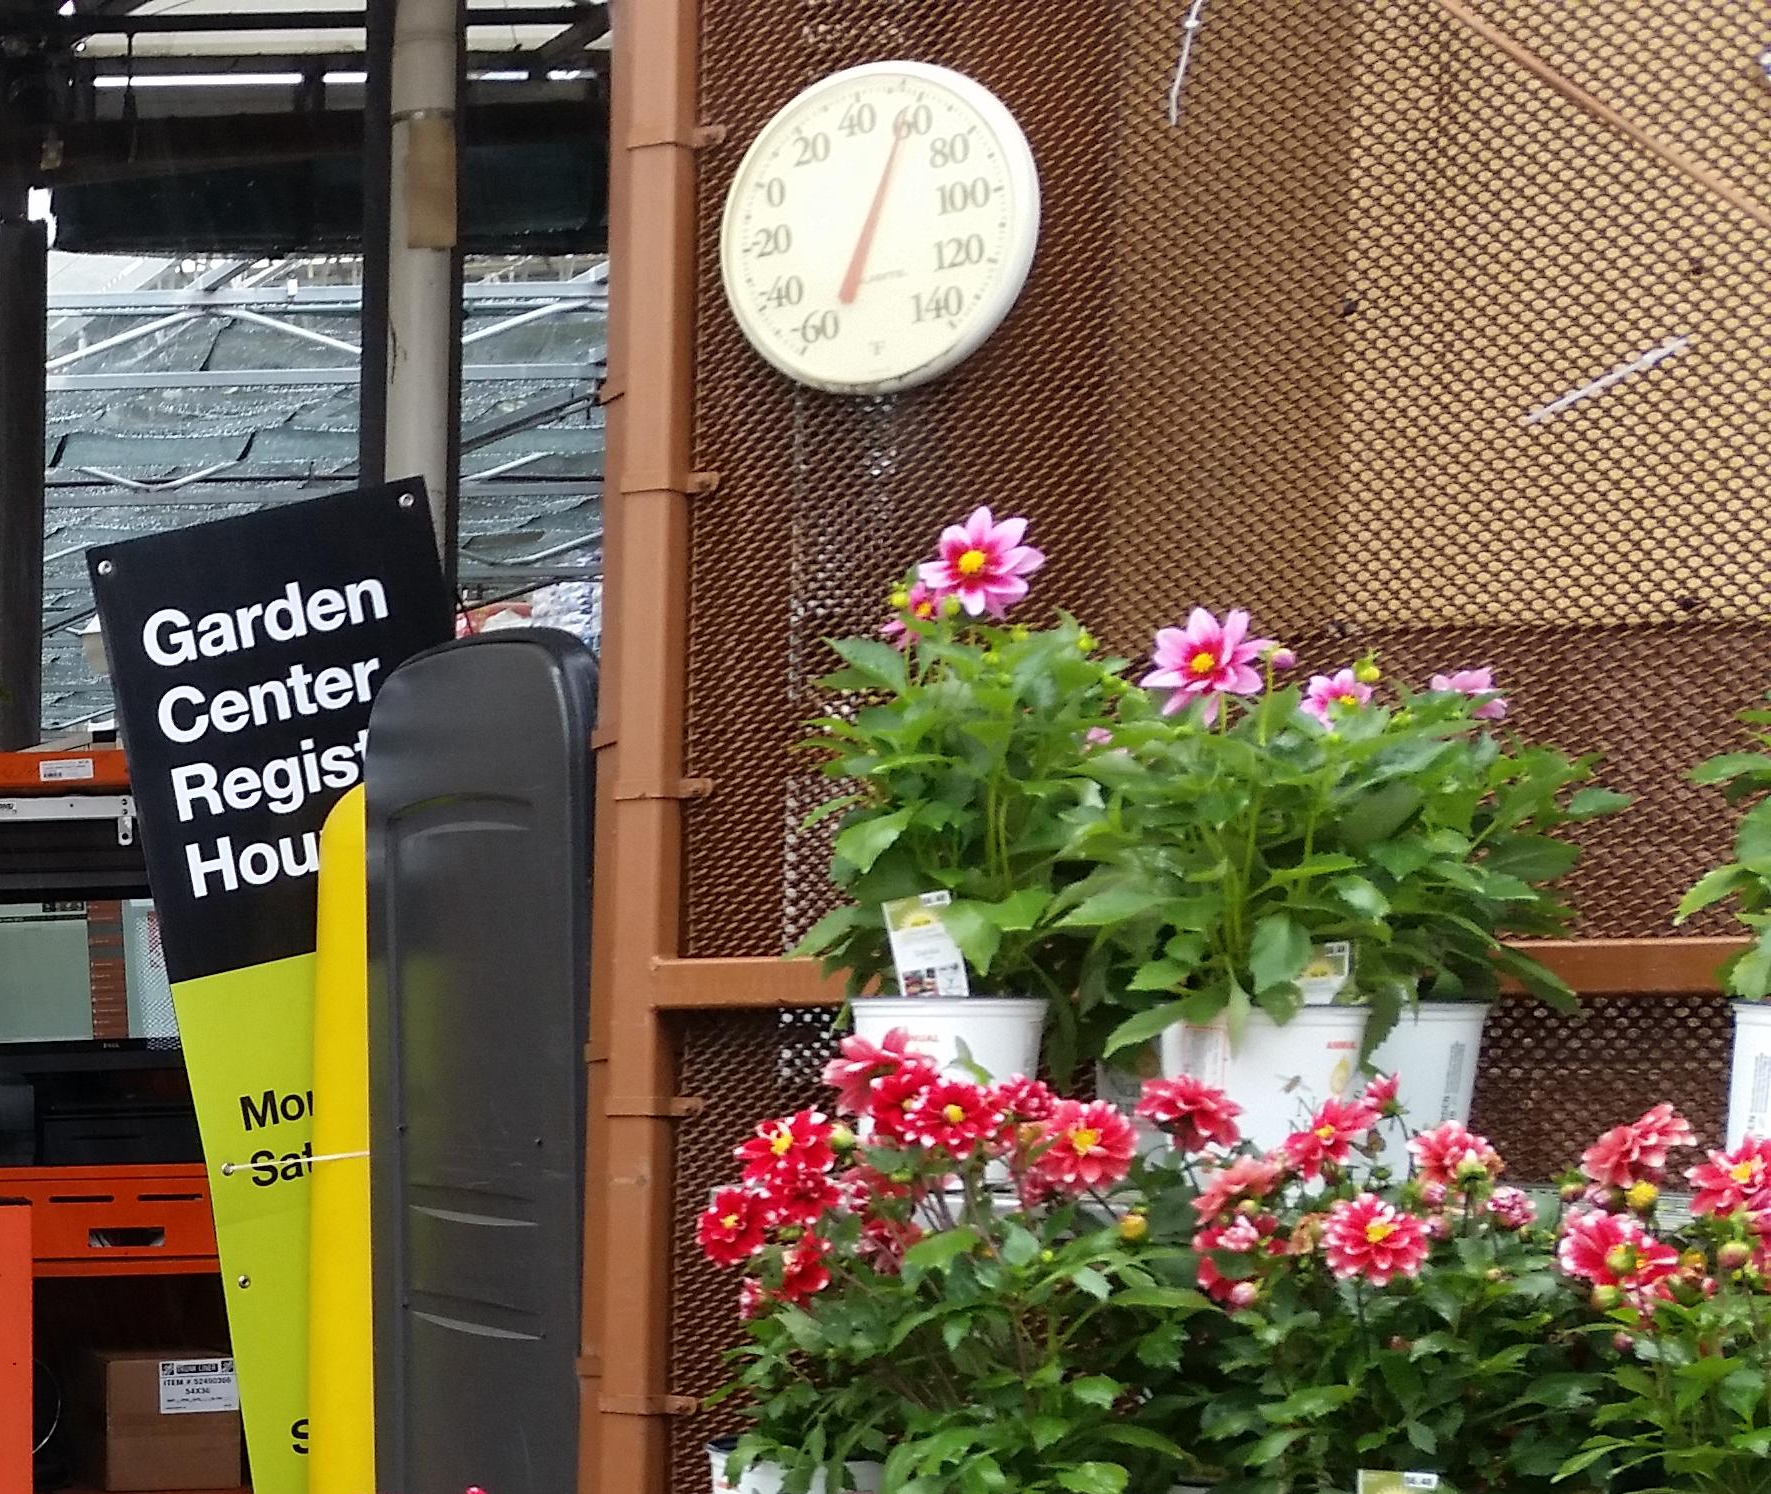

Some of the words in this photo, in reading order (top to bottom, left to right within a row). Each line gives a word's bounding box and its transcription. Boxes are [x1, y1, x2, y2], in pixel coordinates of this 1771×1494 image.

[838, 102, 877, 137] 40
[893, 104, 932, 140] 60
[793, 132, 831, 167] 20
[929, 132, 970, 168] 80
[765, 176, 786, 208] 0
[935, 176, 990, 216] 100
[752, 223, 792, 258] -20
[933, 233, 985, 272] 120
[759, 275, 804, 308] -40
[911, 285, 964, 324] 140
[791, 309, 840, 344] -60
[142, 577, 390, 667] Garden
[158, 655, 381, 744] Center
[171, 728, 369, 823] Regist
[185, 831, 320, 898] Hou
